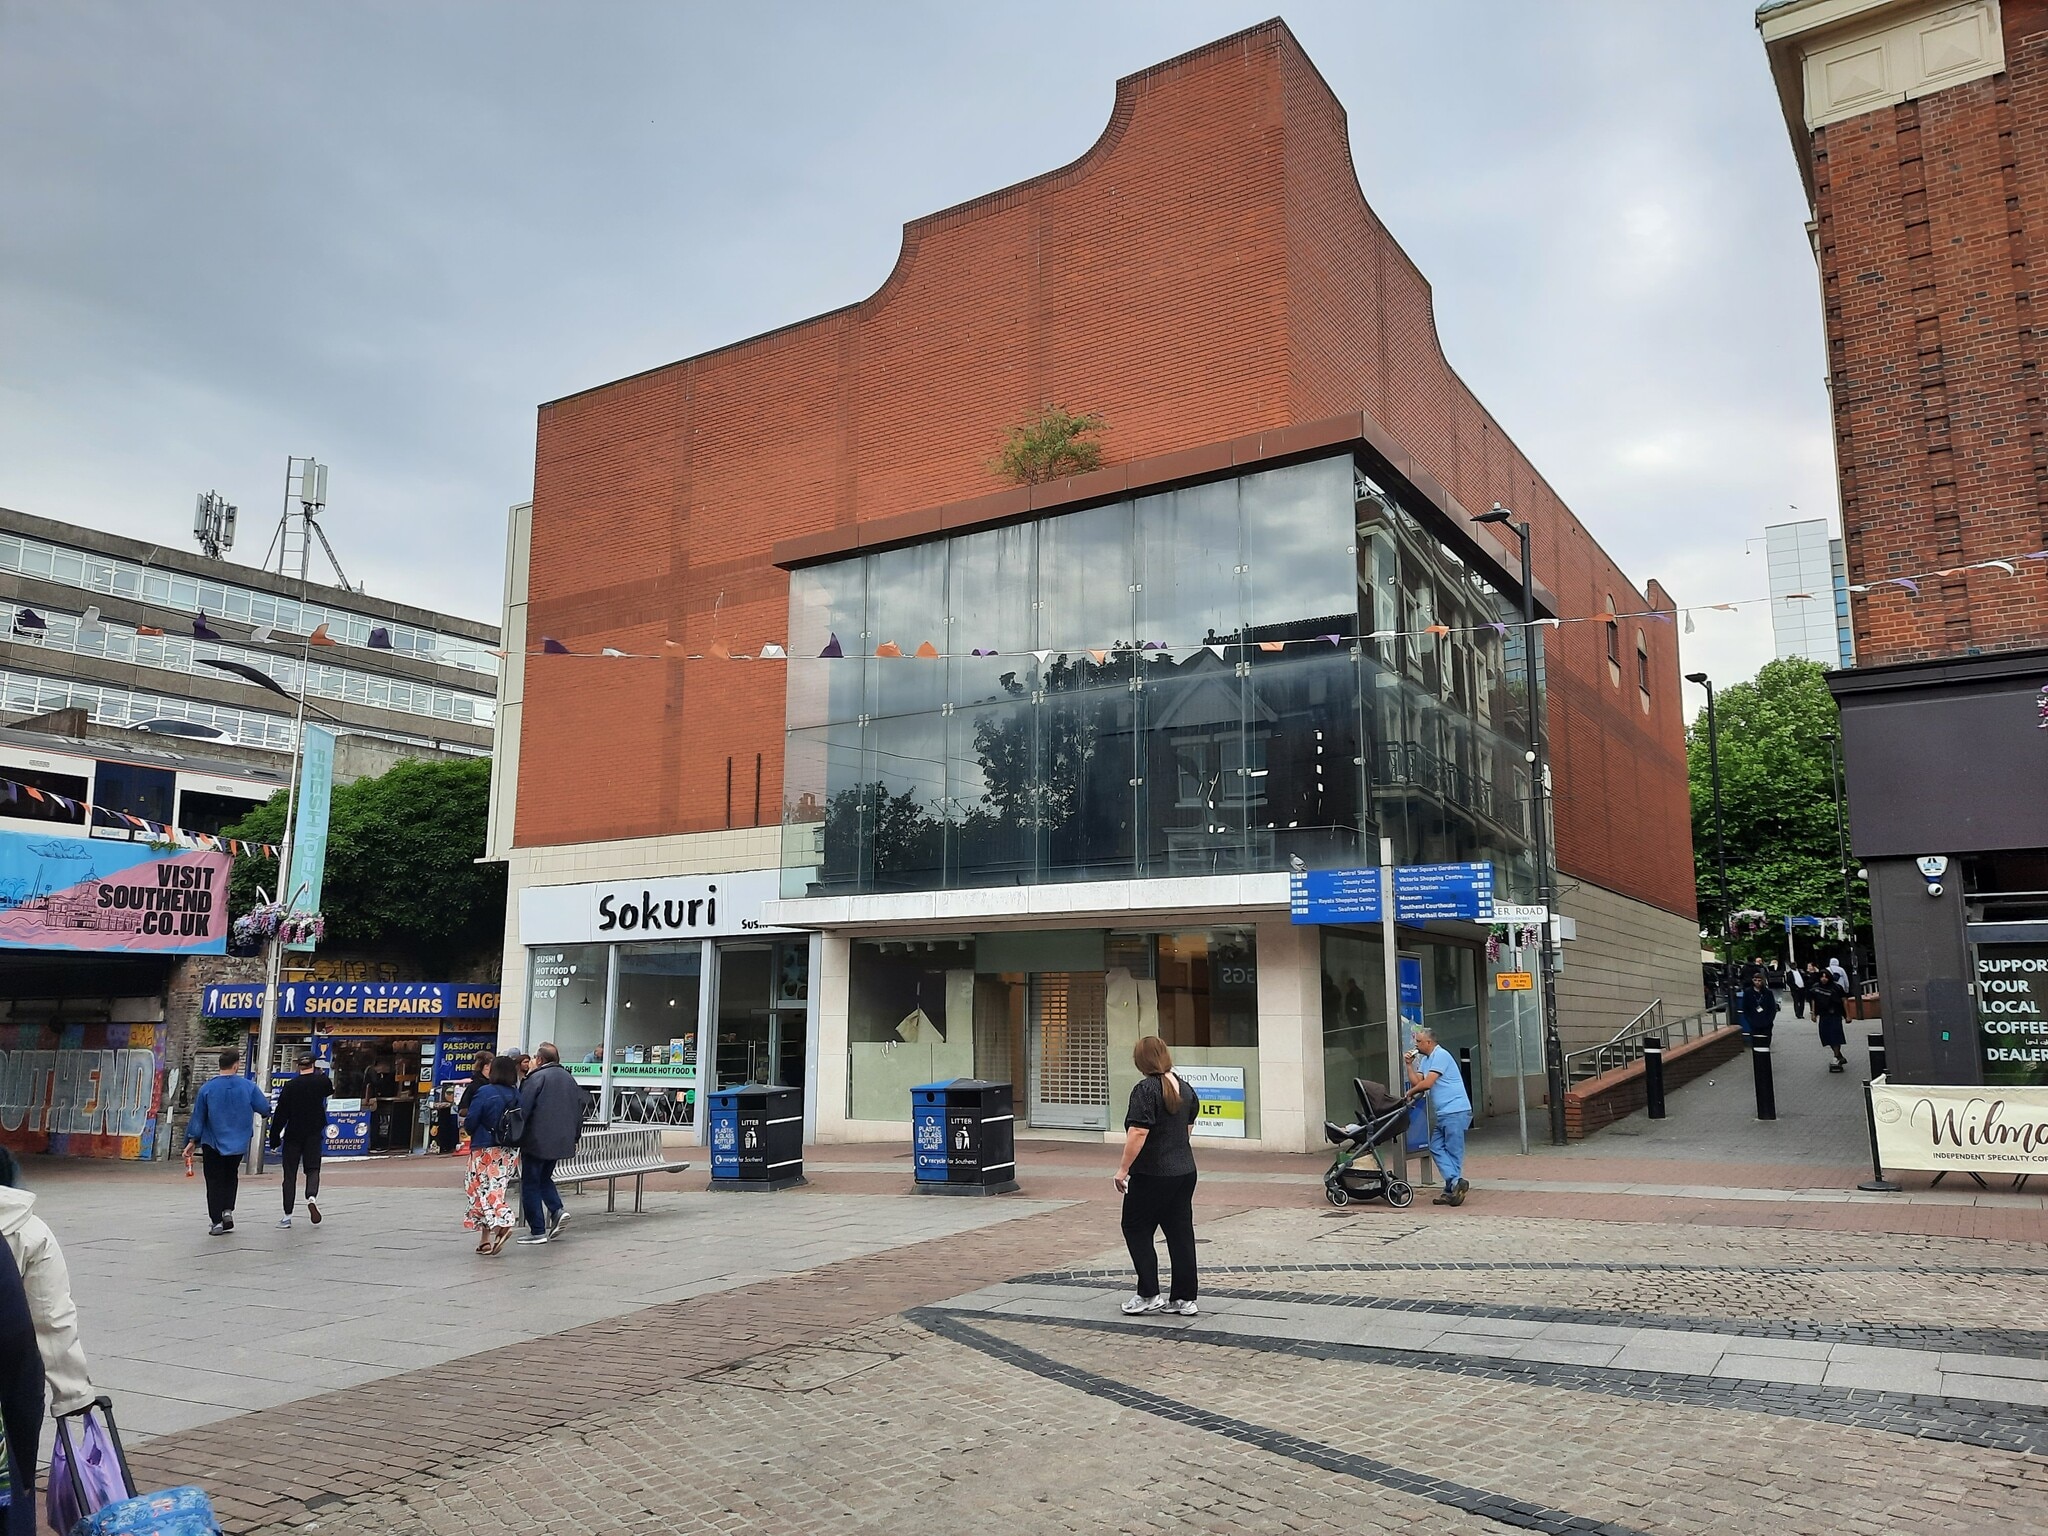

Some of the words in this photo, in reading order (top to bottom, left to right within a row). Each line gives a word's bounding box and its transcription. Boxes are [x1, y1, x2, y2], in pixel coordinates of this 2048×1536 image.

[306, 748, 325, 828] FRESH
[157, 864, 214, 890] VISIT
[97, 884, 212, 913] SOUTHEND
[598, 885, 717, 930] Sokuri
[1515, 907, 1544, 916] ROAD
[135, 911, 210, 937] .CO.UK
[536, 954, 556, 963] SUSHI
[535, 966, 549, 975] HOT
[550, 966, 569, 975] FOOD
[1978, 959, 2048, 973] SUPPOR
[534, 978, 562, 987] NOODLE
[1979, 980, 2031, 993] YOUR
[220, 992, 253, 1009] KEYS
[533, 990, 548, 999] RICE
[305, 997, 358, 1013] SHOE
[363, 997, 443, 1014] REPAIRS
[1982, 1000, 2041, 1014] LOCAL
[1984, 1021, 2048, 1034] COFFEE
[443, 1042, 484, 1050] PASSPORT
[486, 1042, 492, 1050] &
[445, 1053, 454, 1061] ID
[455, 1053, 476, 1061] PHOT
[1210, 1072, 1239, 1082] Moore
[1202, 1104, 1222, 1115] LET
[950, 1117, 973, 1125] LITTER
[1932, 1152, 1986, 1161] INDEPENDENT
[1987, 1154, 2030, 1162] SPECIALTY
